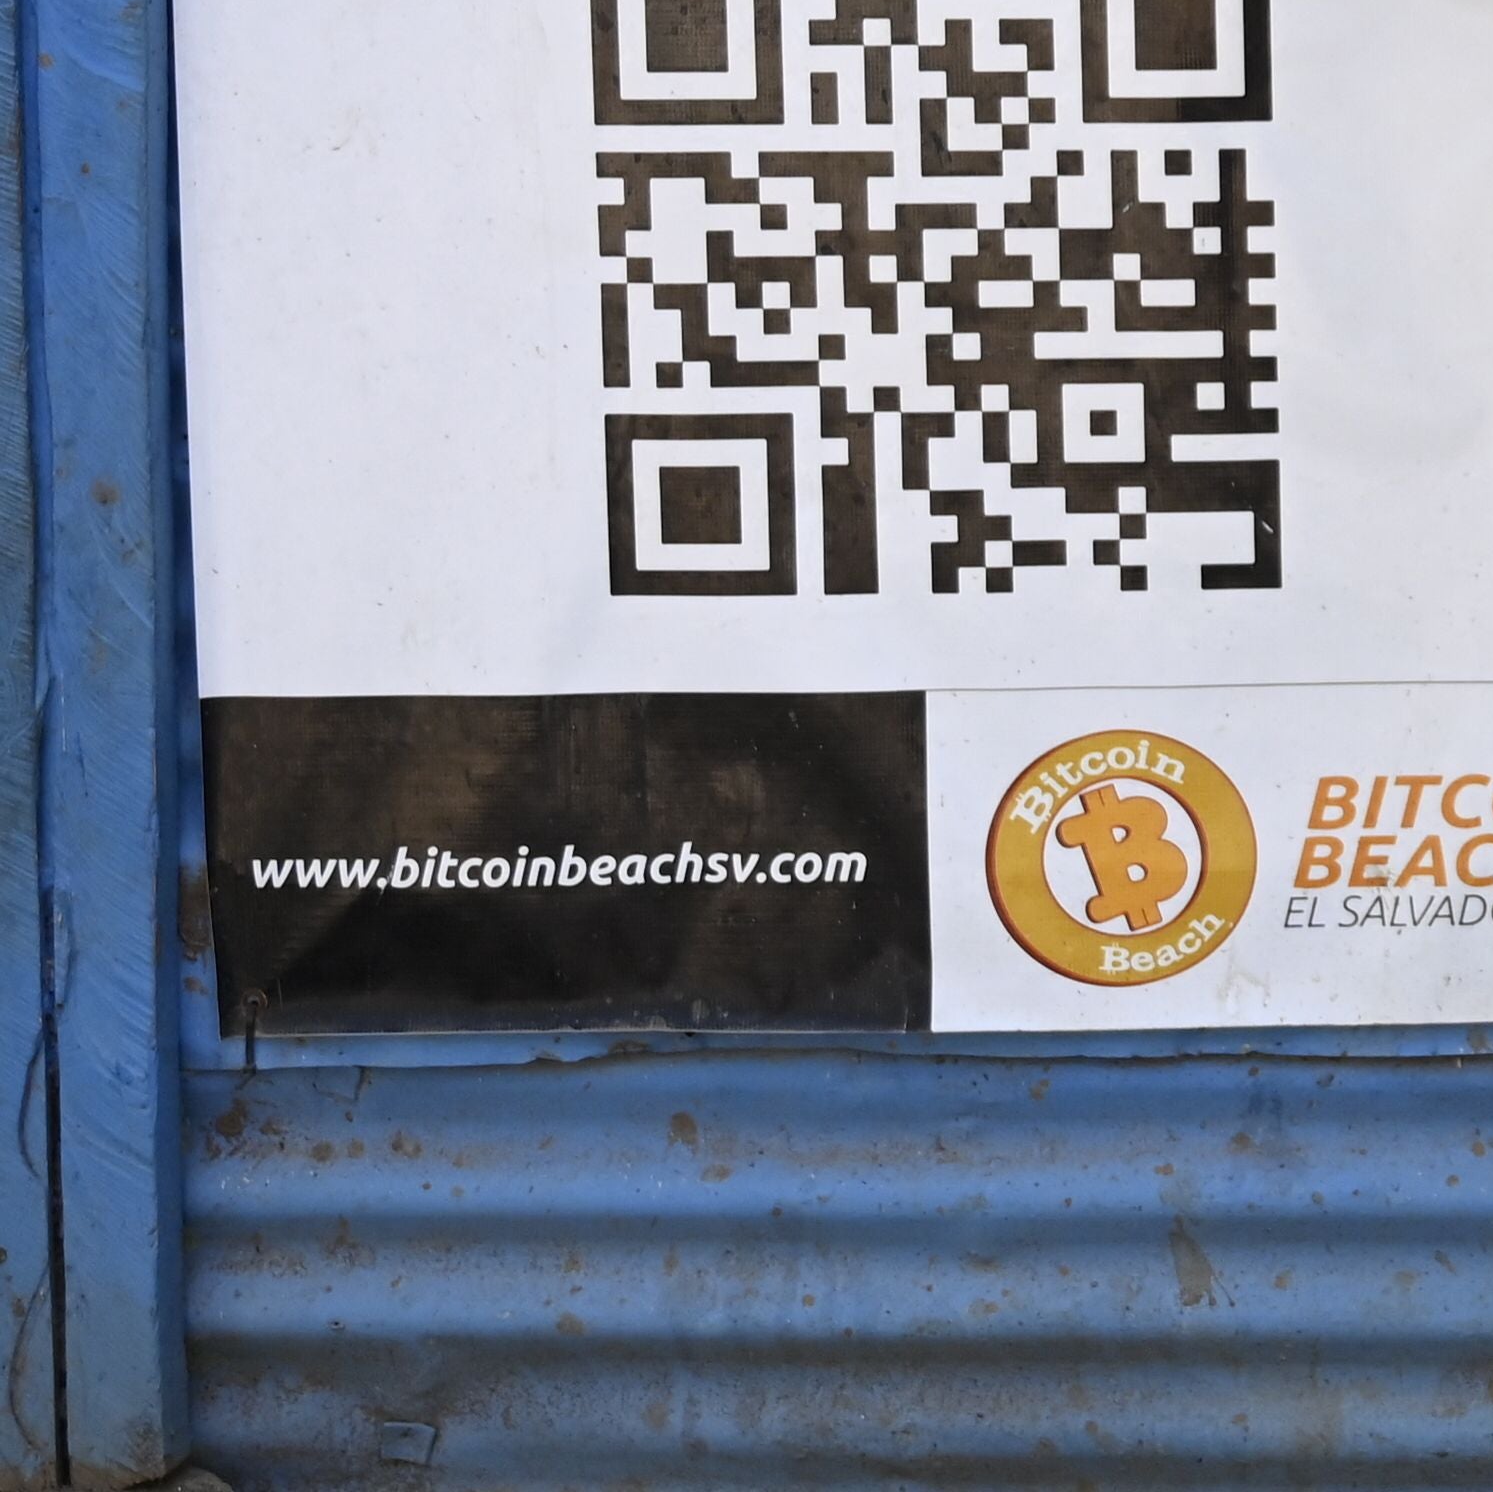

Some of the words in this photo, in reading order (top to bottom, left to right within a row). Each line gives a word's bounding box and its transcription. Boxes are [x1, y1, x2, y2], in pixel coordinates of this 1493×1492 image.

[1009, 739, 1187, 835] Bitcoin
[252, 841, 868, 890] www.bitcoinbeachsv.com
[1283, 897, 1326, 930] EL
[1099, 912, 1226, 975] Beach
